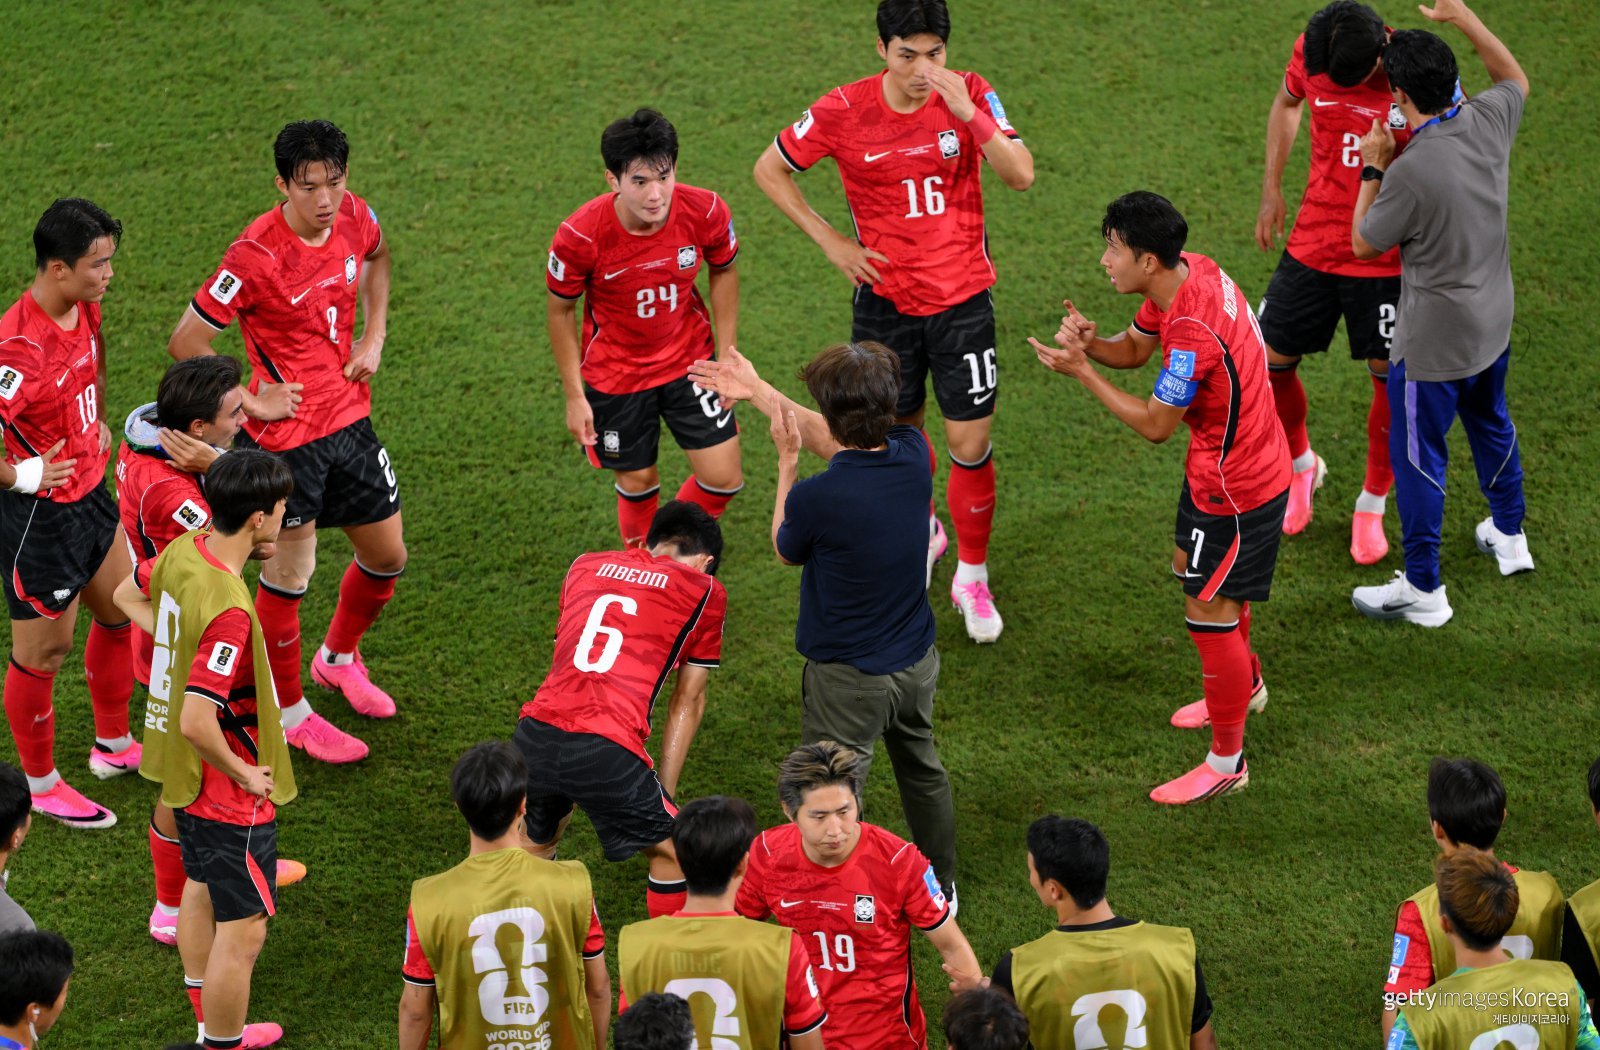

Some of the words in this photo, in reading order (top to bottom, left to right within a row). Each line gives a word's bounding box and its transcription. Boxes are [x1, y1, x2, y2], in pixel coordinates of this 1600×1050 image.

[901, 175, 946, 219] 16
[636, 283, 678, 319] 24
[326, 306, 340, 345] 2
[963, 347, 997, 394] 16
[1162, 377, 1187, 394] UNITES
[1164, 372, 1187, 388] FOOTBALL
[75, 383, 97, 434] 18
[377, 447, 396, 488] 2
[1190, 527, 1205, 569] 7
[595, 563, 669, 589] INBEOM
[573, 593, 639, 674] 6
[812, 931, 856, 973] 19
[503, 1002, 536, 1015] FIFA
[485, 1029, 532, 1042] WORLD
[534, 1021, 551, 1039] CUP
